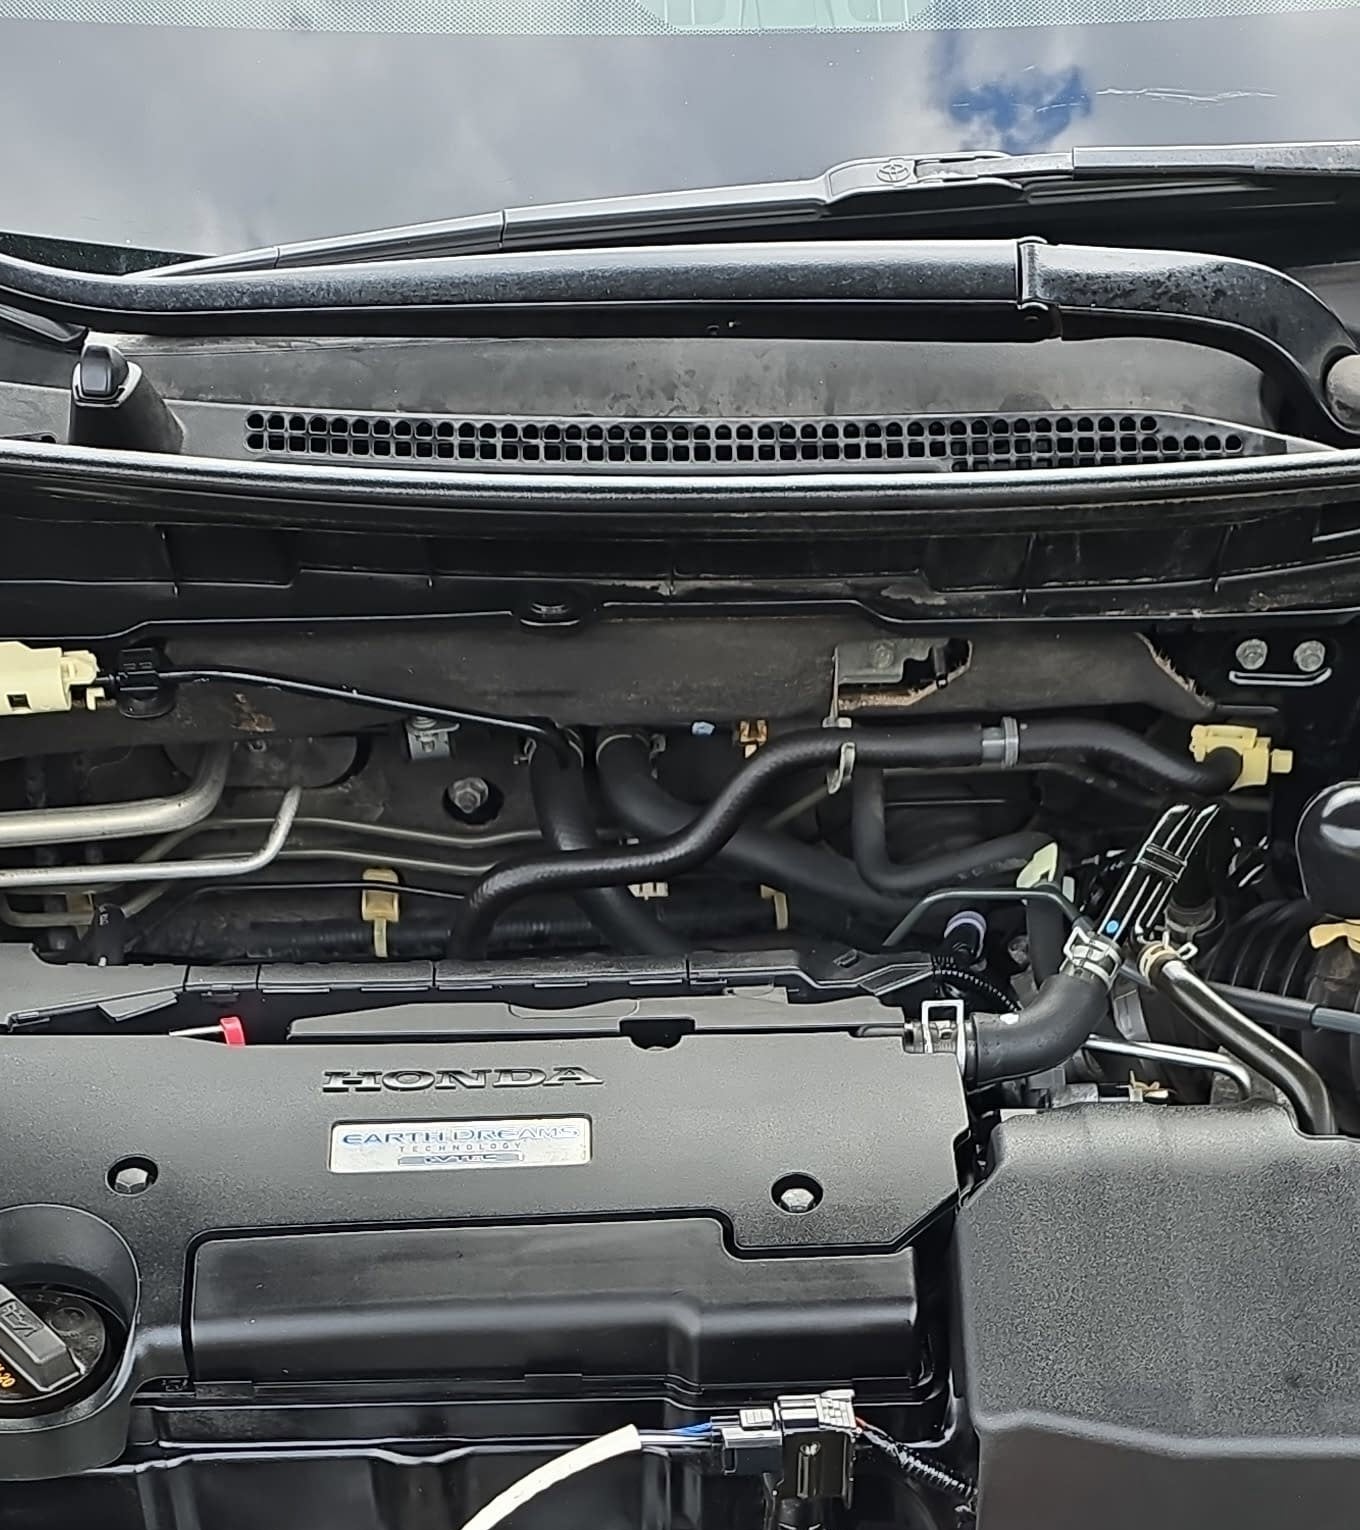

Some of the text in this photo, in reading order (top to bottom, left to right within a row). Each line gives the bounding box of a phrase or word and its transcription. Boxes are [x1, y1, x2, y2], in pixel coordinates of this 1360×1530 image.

[323, 1066, 605, 1092] HONDA
[343, 1128, 580, 1144] EARTH DREAMS
[400, 1142, 521, 1152] TECHNOLOGY
